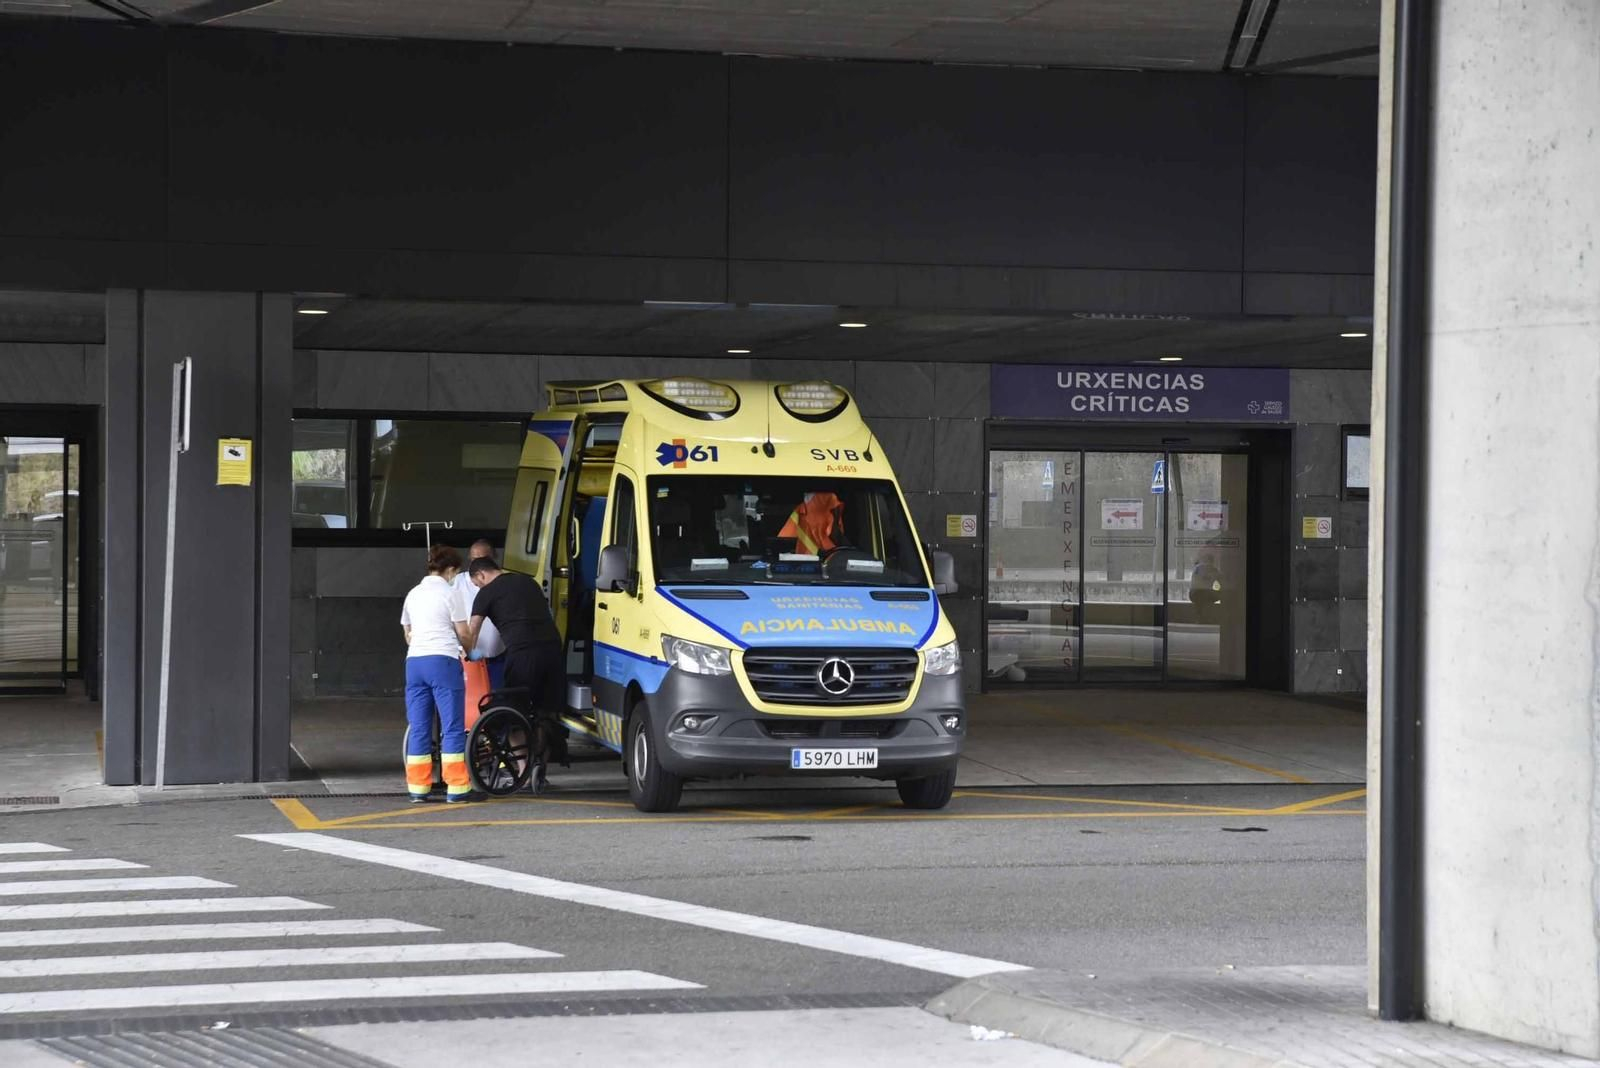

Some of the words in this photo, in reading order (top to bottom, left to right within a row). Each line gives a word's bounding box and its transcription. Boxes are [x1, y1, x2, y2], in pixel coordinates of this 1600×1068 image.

[1057, 372, 1205, 390] URXENCIAS
[1071, 392, 1190, 413] CRÍTICAS
[672, 444, 718, 462] 061
[811, 448, 859, 461] SVB
[826, 464, 857, 473] A-669
[1061, 462, 1075, 673] EMERXENCIAS
[804, 751, 842, 766] 5970
[847, 751, 875, 766] LHM
